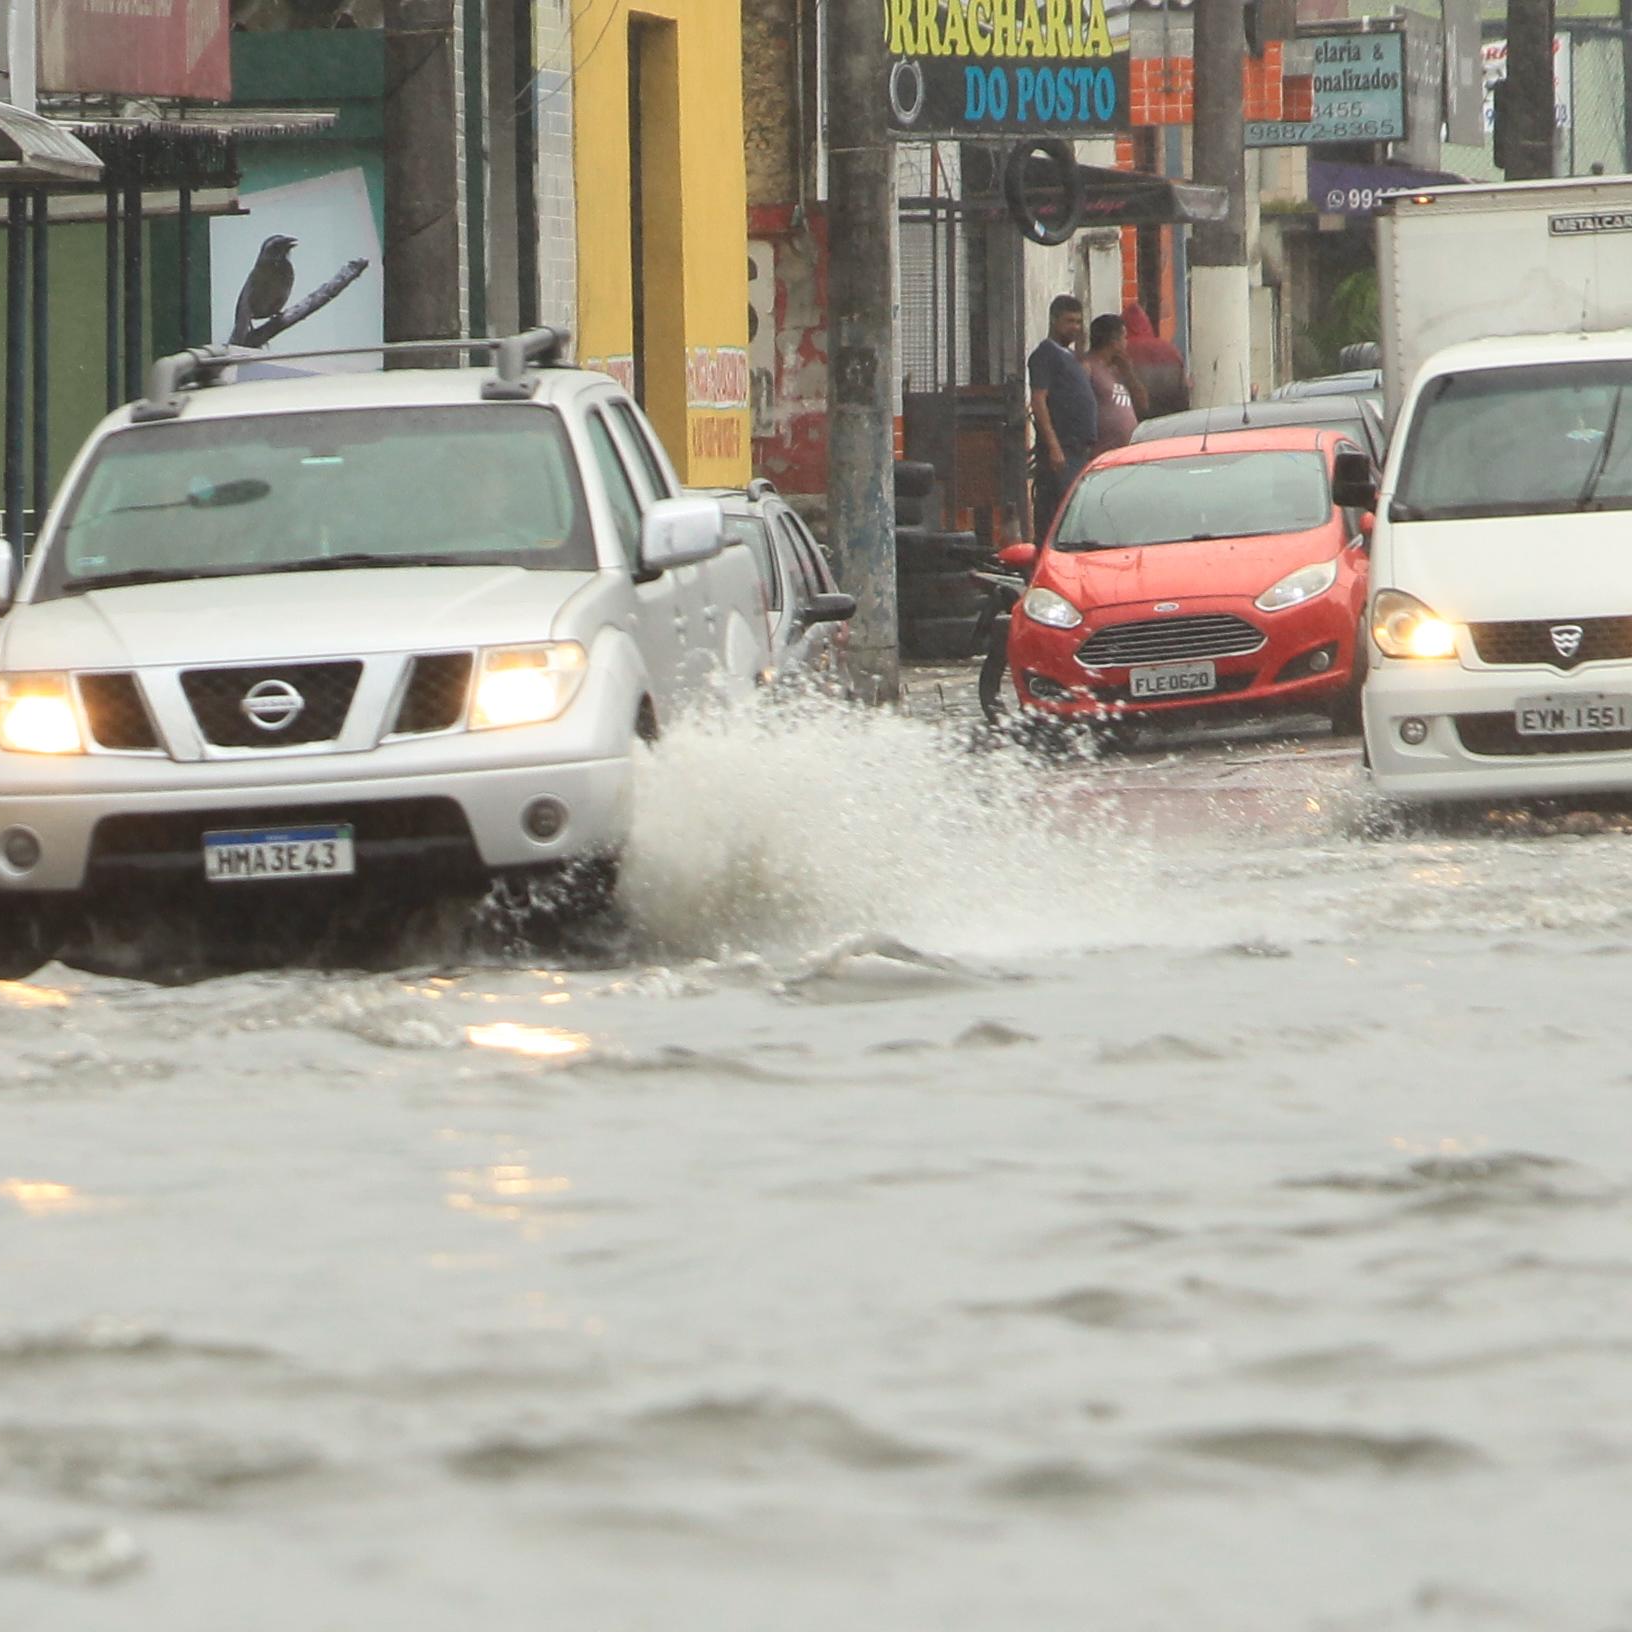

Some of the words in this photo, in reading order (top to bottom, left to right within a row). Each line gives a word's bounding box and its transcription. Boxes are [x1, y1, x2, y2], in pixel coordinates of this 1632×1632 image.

[884, 0, 1112, 57] RRACHARIA
[1314, 39, 1361, 64] elaria
[1372, 42, 1385, 61] &
[965, 66, 1009, 120] DO
[1018, 66, 1115, 121] POSTO
[218, 843, 337, 873] HMA3E43
